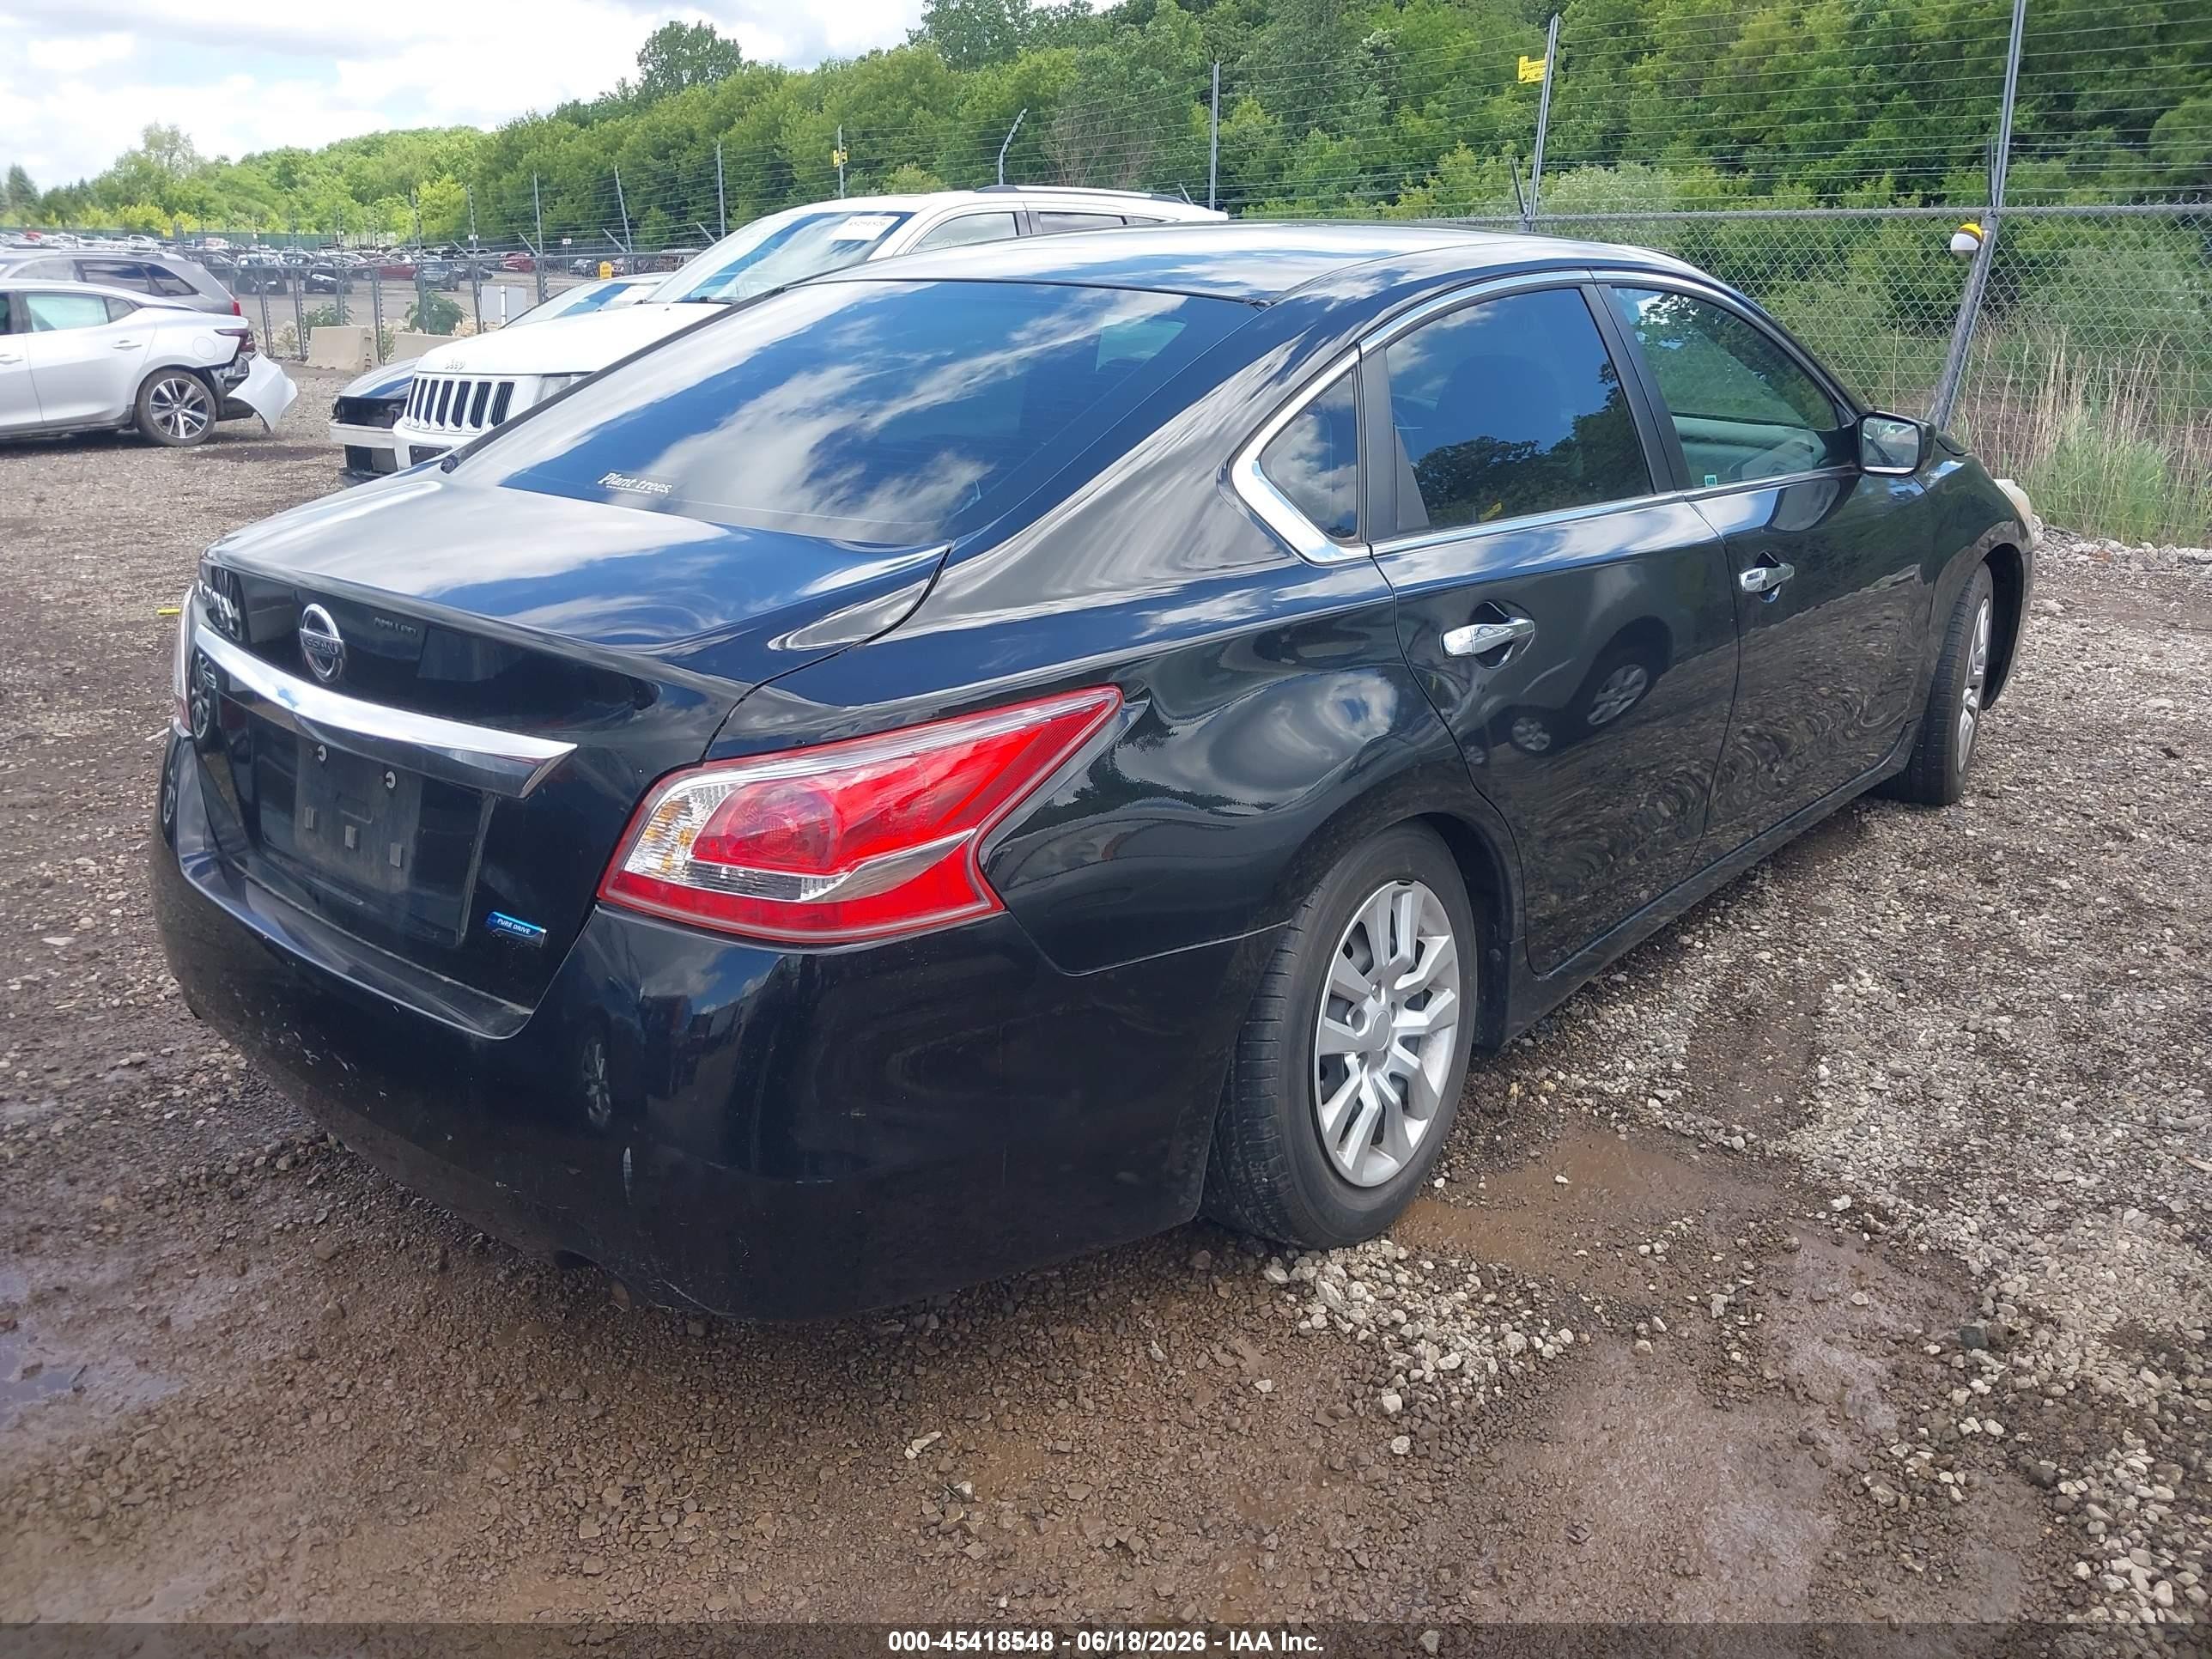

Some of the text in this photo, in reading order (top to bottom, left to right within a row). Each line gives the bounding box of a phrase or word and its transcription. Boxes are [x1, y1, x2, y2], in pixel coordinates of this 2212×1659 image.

[598, 472, 637, 486] Plant
[496, 918, 531, 934] PURE DRIVE
